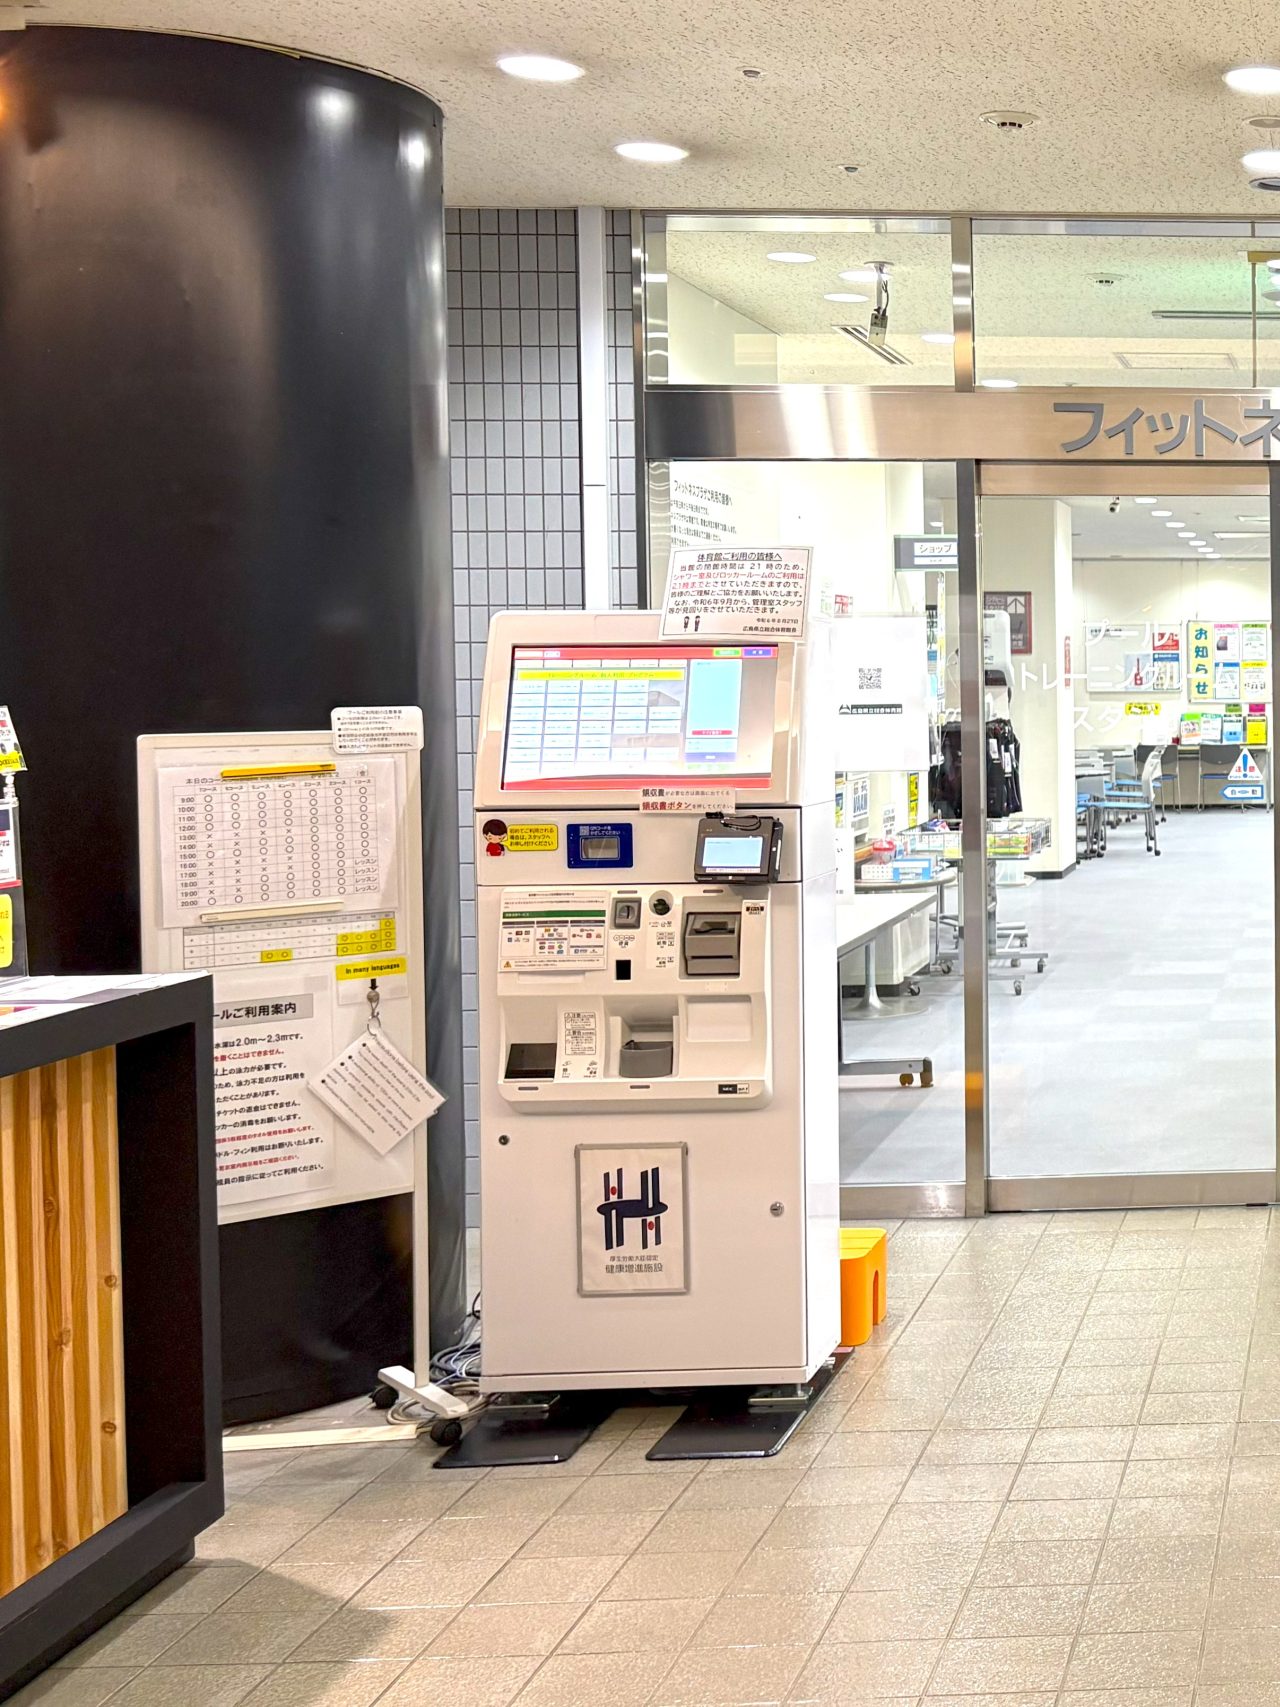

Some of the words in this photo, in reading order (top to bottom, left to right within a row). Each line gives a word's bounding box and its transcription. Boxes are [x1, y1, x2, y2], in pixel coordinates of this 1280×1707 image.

[919, 544, 953, 554] ショップ
[697, 552, 783, 563] 体育館ご利用の皆様へ
[1194, 627, 1209, 695] お知らせ
